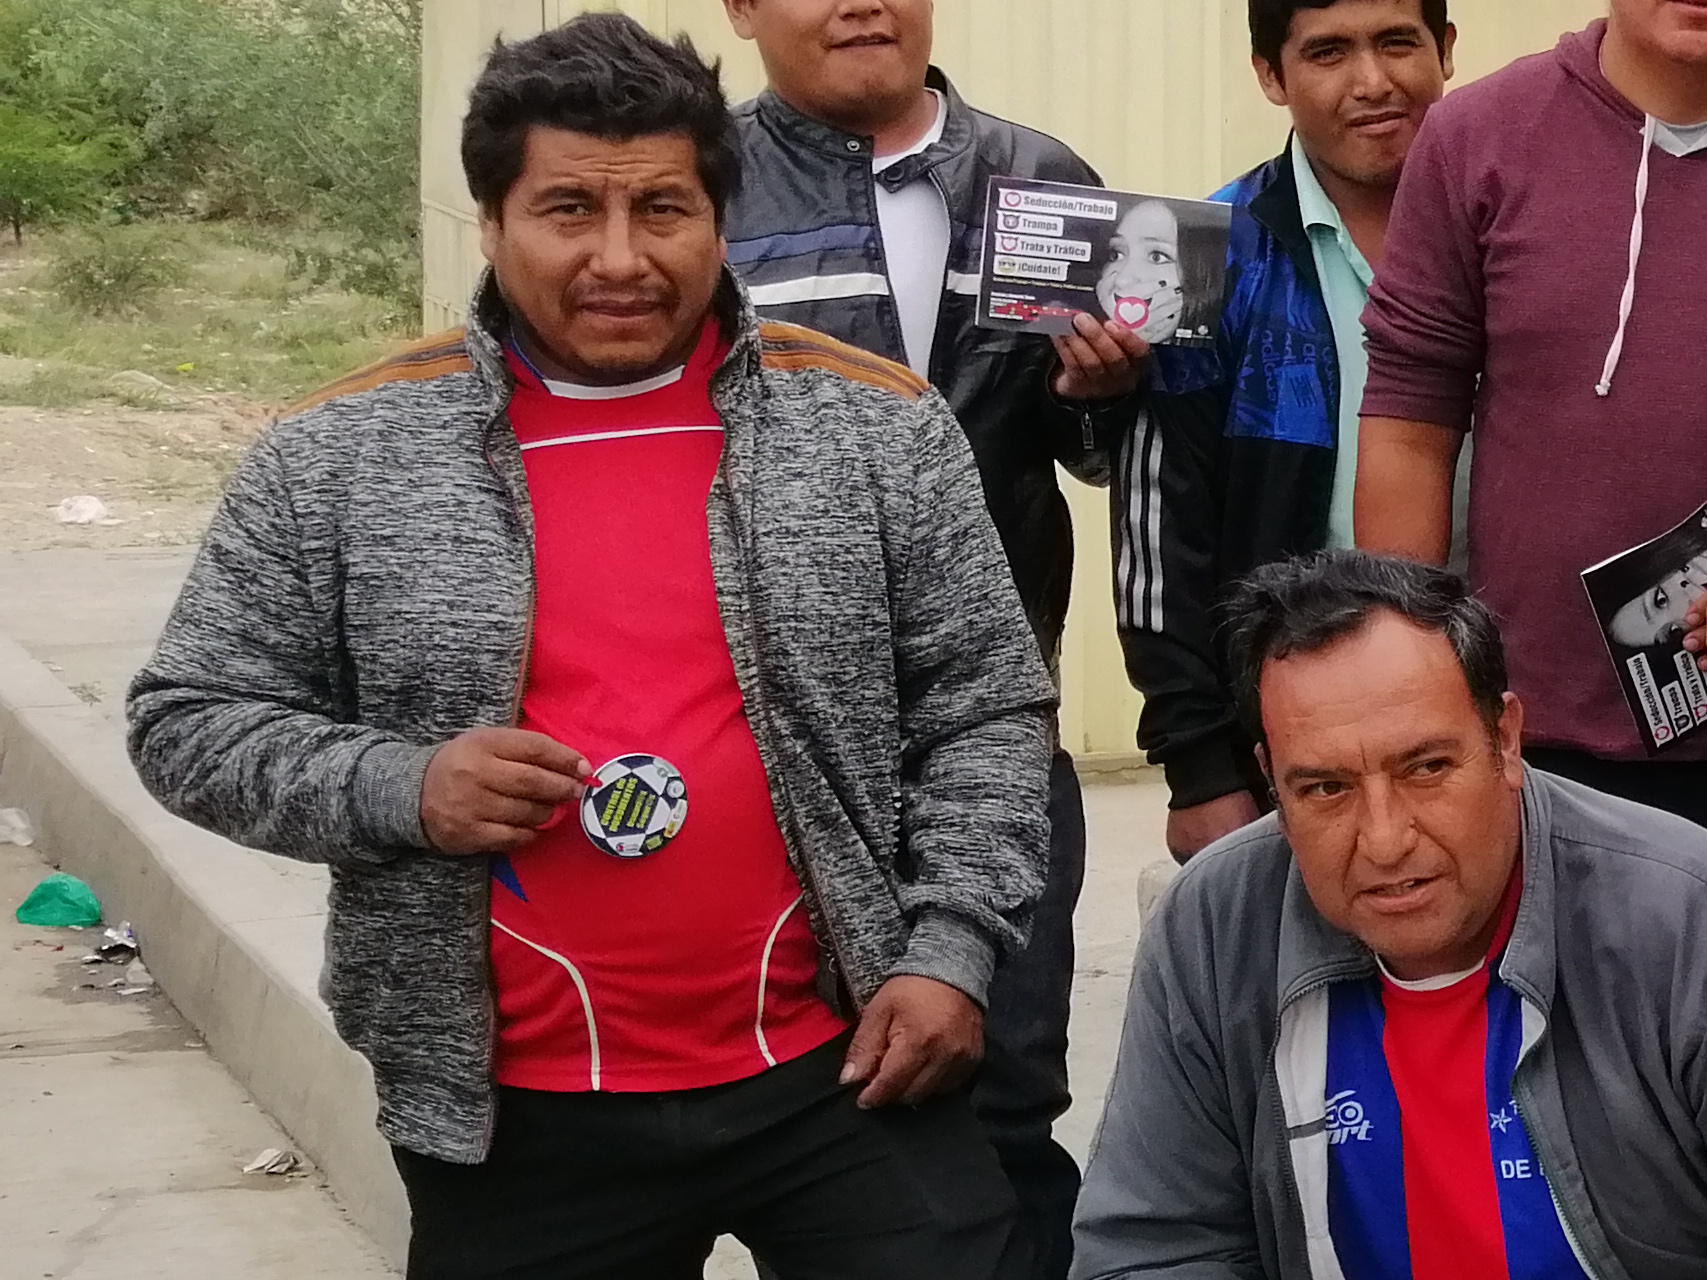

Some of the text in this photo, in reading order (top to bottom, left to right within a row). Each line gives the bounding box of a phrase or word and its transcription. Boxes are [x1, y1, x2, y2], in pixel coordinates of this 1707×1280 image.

[1022, 219, 1057, 231] Trampa
[1020, 241, 1044, 252] Trata
[1046, 245, 1052, 254] y
[1500, 1159, 1532, 1179] DE
